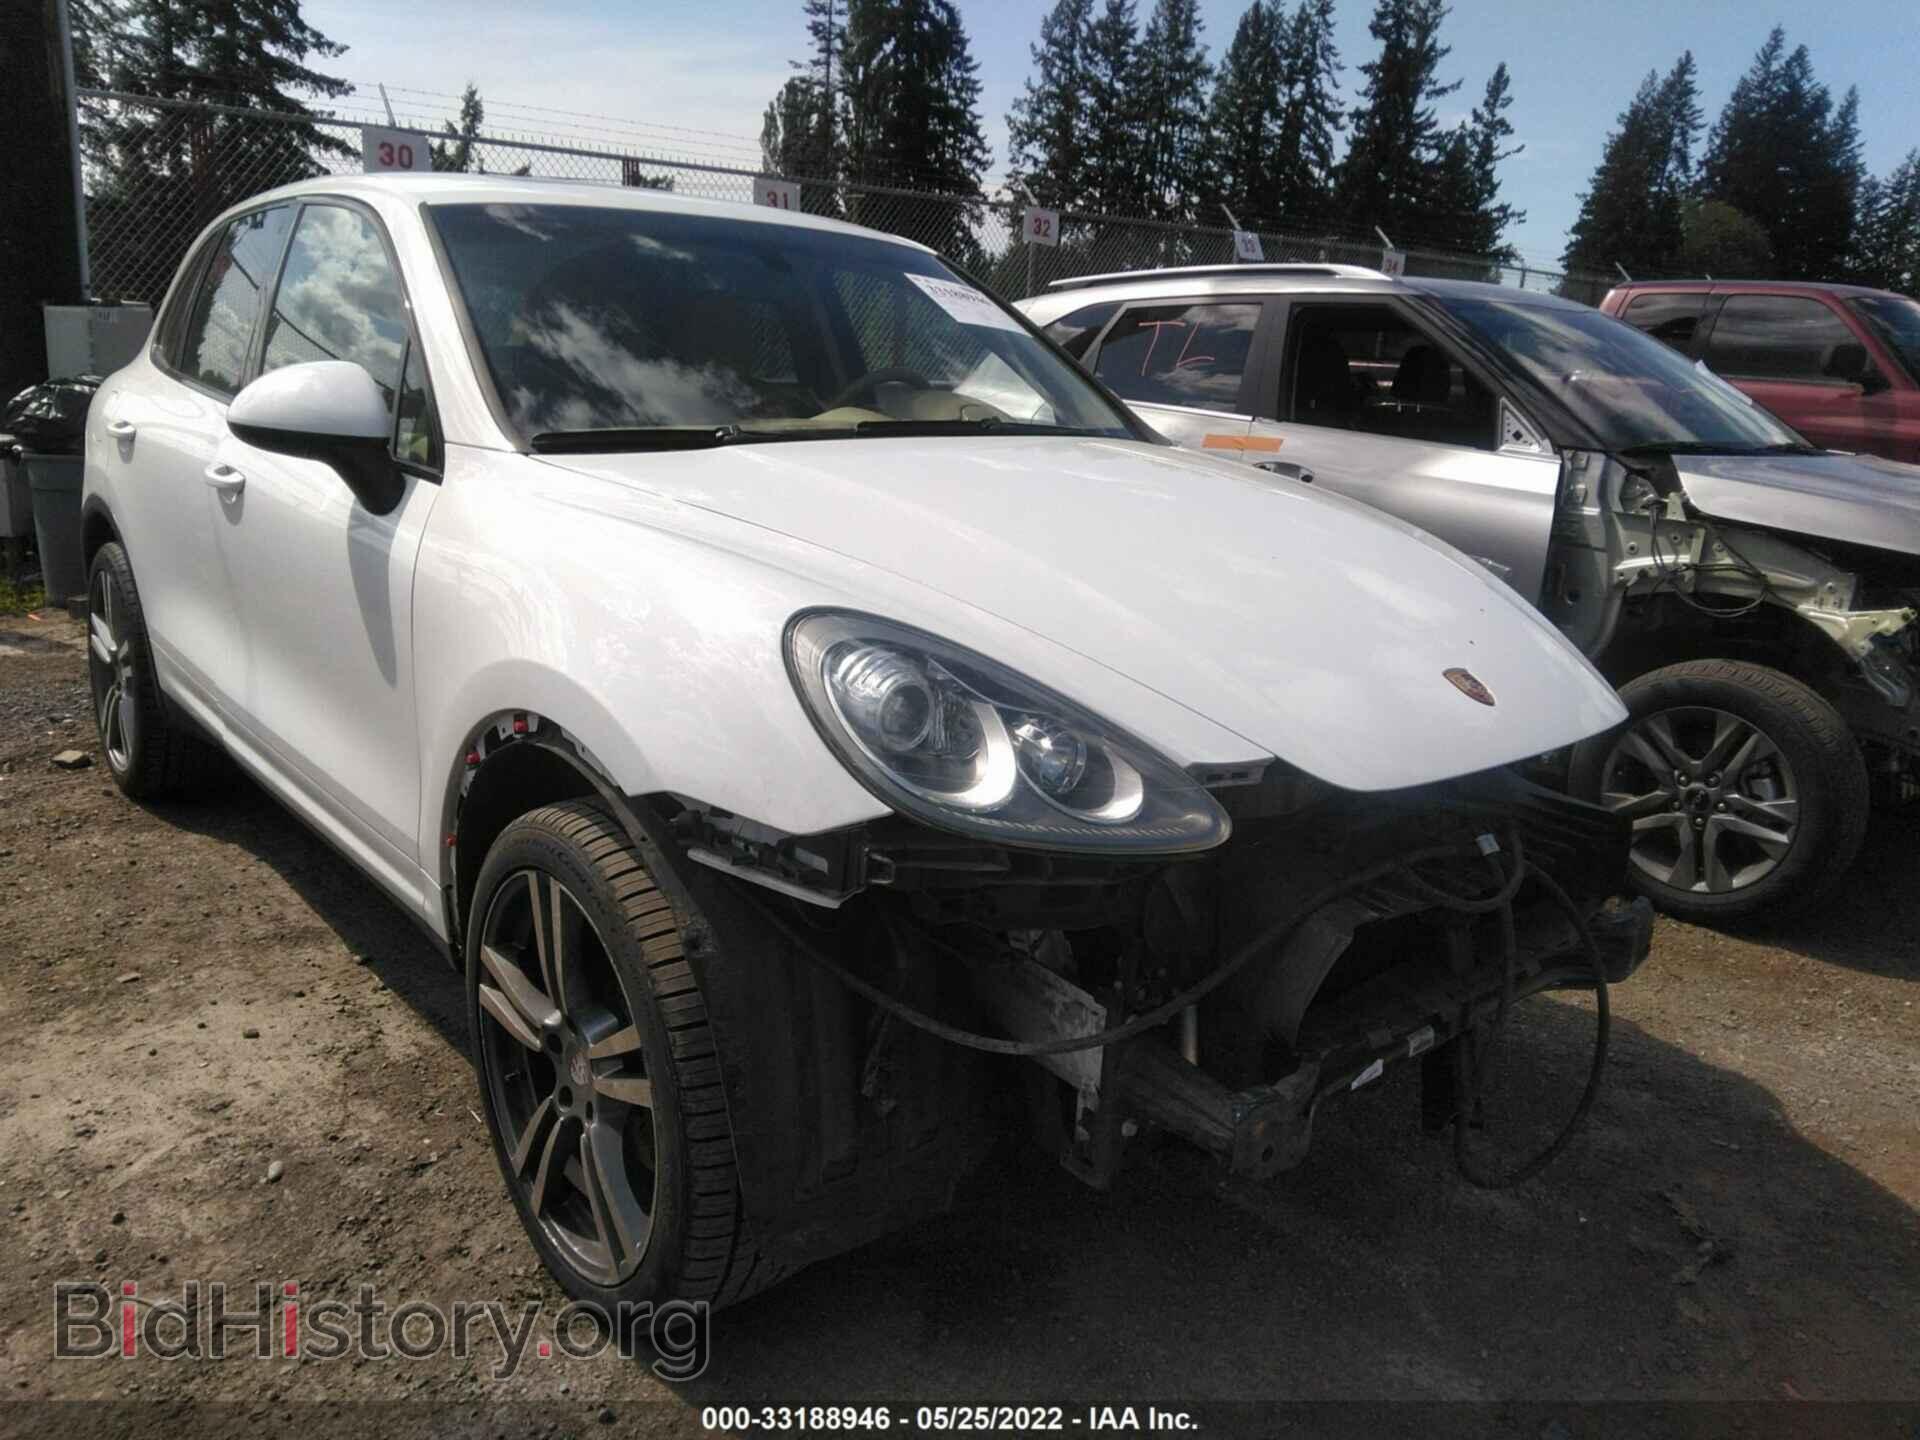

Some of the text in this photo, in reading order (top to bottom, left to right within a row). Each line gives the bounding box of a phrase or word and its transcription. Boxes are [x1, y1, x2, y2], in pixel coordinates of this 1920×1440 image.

[378, 142, 413, 169] 30
[767, 191, 788, 209] 31
[1033, 217, 1050, 237] 32
